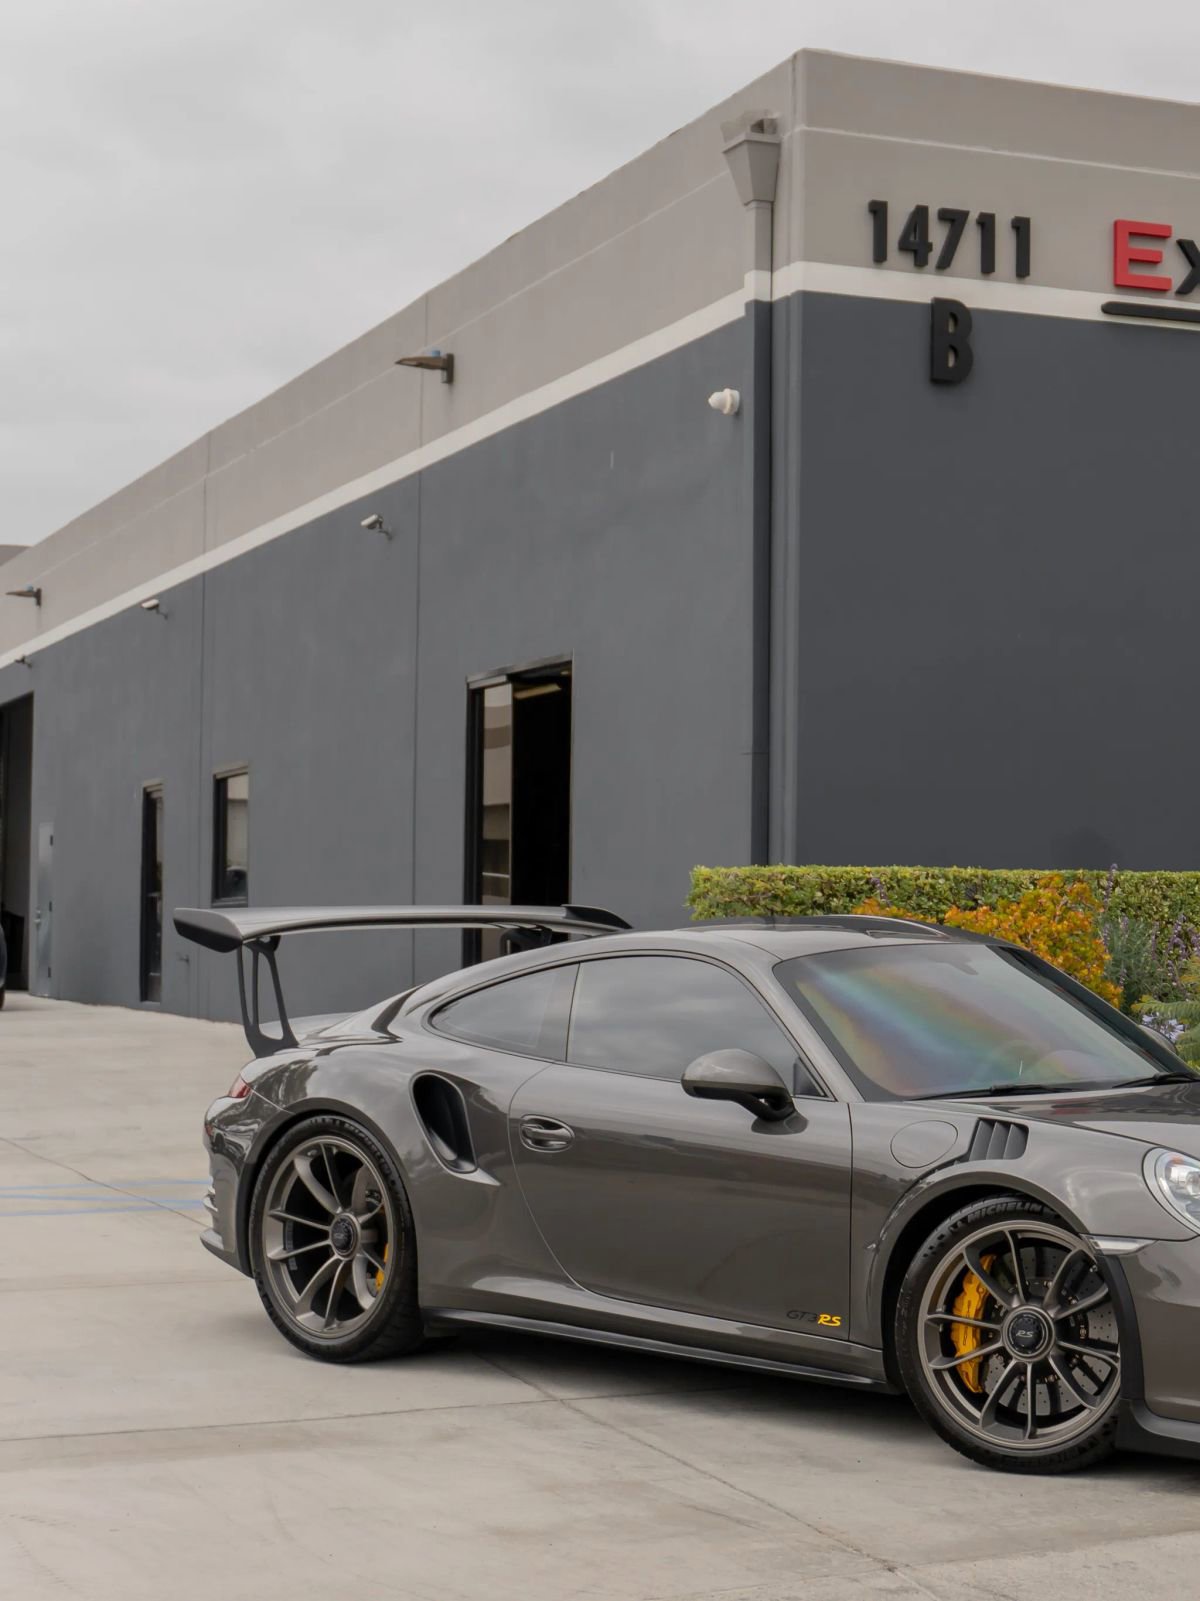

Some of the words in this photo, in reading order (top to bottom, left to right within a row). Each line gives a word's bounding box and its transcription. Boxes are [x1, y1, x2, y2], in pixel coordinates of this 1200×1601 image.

[868, 199, 1031, 278] 14711
[929, 296, 974, 384] B
[967, 1201, 1042, 1223] MICHELIN
